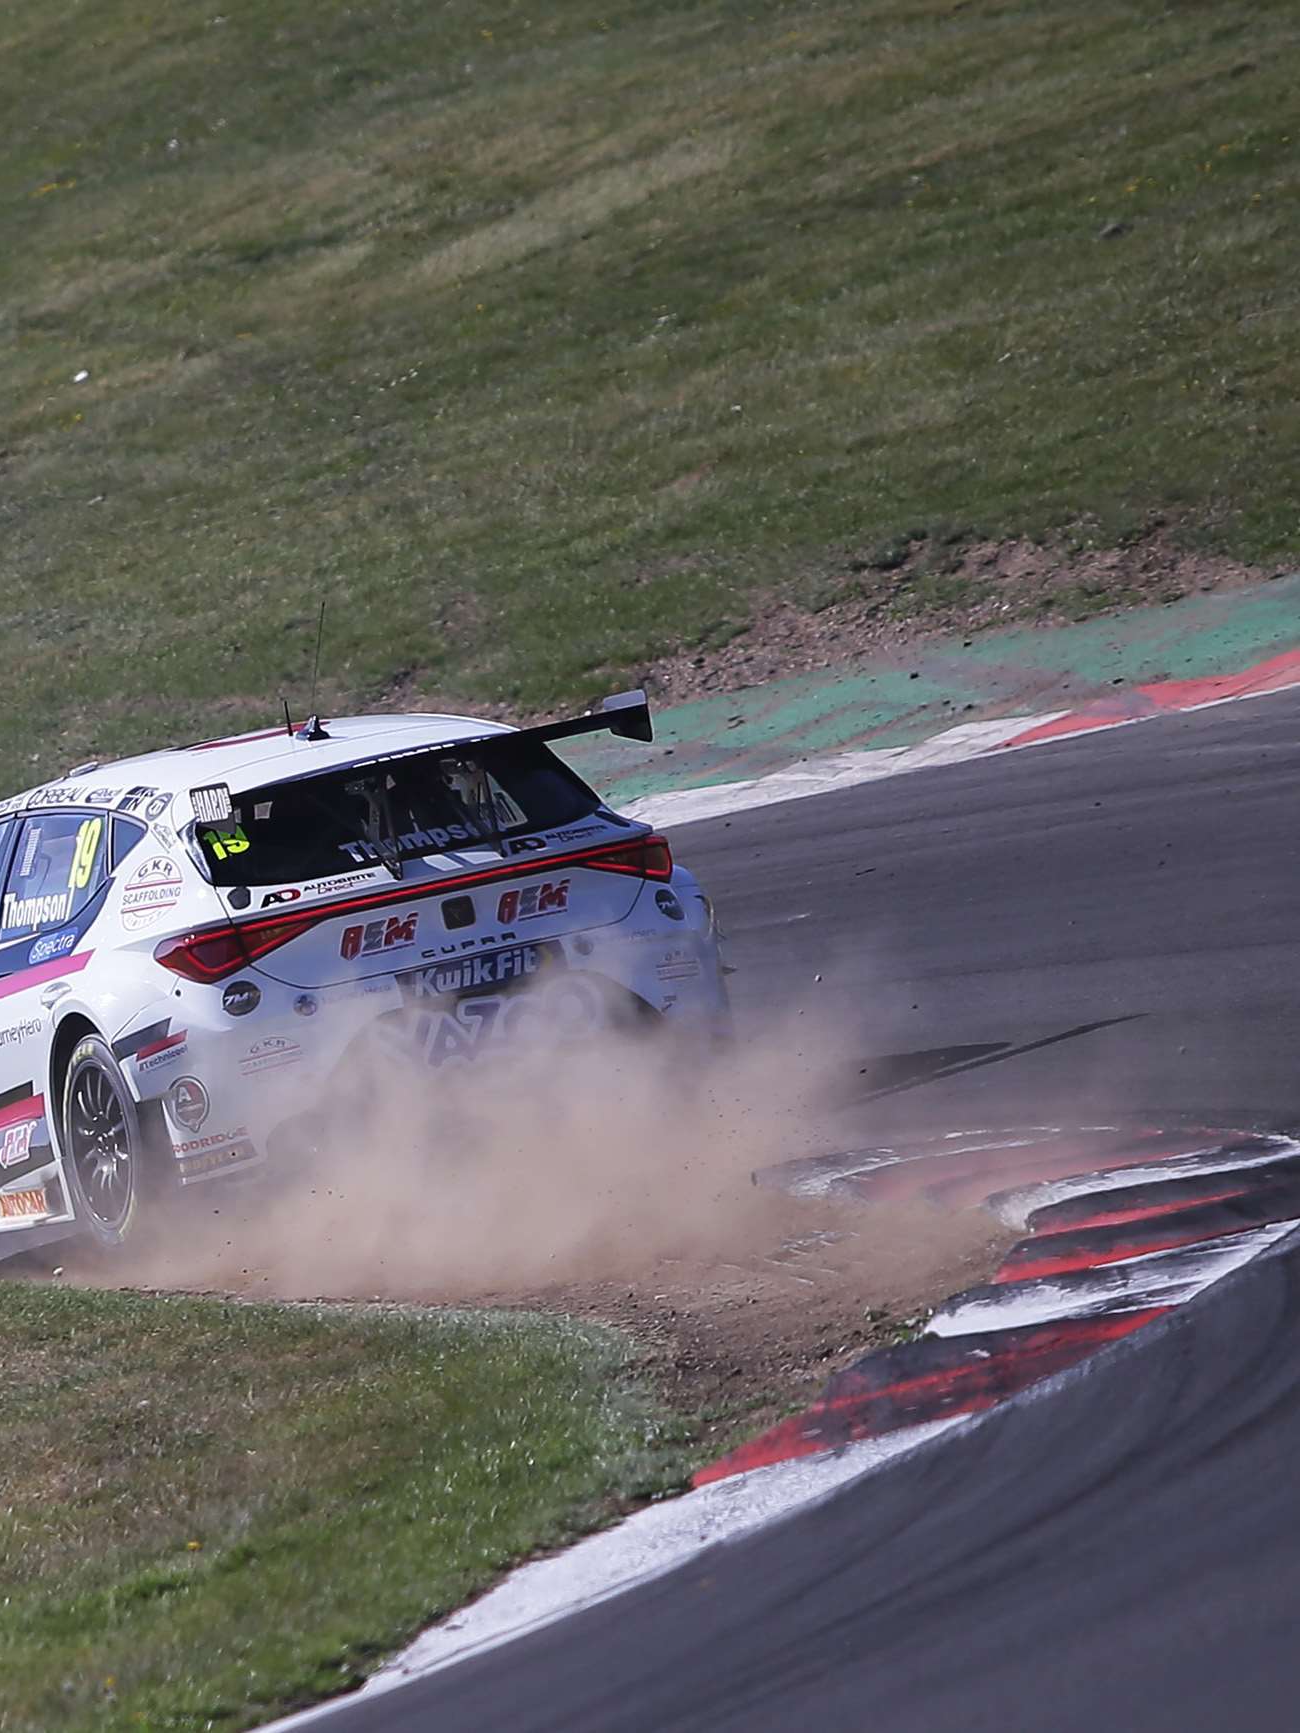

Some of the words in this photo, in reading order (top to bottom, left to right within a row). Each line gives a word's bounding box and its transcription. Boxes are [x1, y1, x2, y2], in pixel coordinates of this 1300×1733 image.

[196, 787, 229, 823] HARD
[68, 817, 102, 889] 19
[137, 859, 173, 878] GKR
[303, 872, 376, 892] AUTOBRITE
[317, 882, 356, 895] Direct
[122, 887, 182, 906] SCAFFOLDING
[2, 892, 68, 931] Thompson
[31, 933, 75, 959] Spectra
[421, 932, 516, 958] CUPRA
